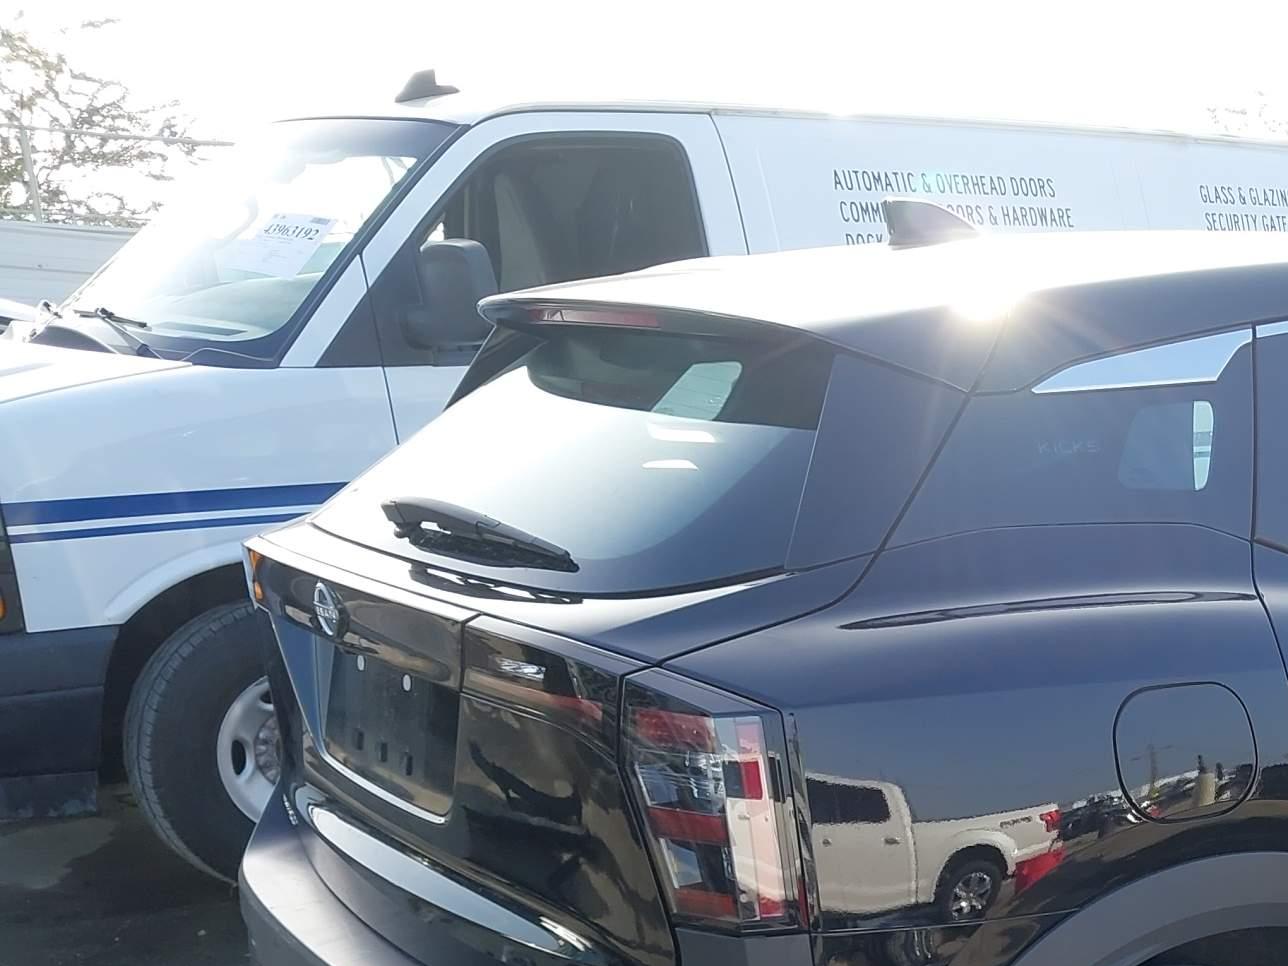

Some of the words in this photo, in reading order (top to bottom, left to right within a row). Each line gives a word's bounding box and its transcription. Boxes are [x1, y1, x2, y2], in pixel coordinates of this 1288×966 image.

[833, 169, 917, 192] AUTOMATIC
[920, 173, 932, 193] &
[934, 173, 1006, 196] OVERHEAD
[1010, 177, 1056, 198] DOORS
[1199, 185, 1235, 205] GLASS
[1238, 187, 1247, 205] &
[839, 201, 888, 223] COMM
[989, 206, 998, 225] &
[1002, 207, 1075, 228] HARDWARE
[1205, 212, 1257, 231] SECURITY
[263, 224, 320, 240] 43963192
